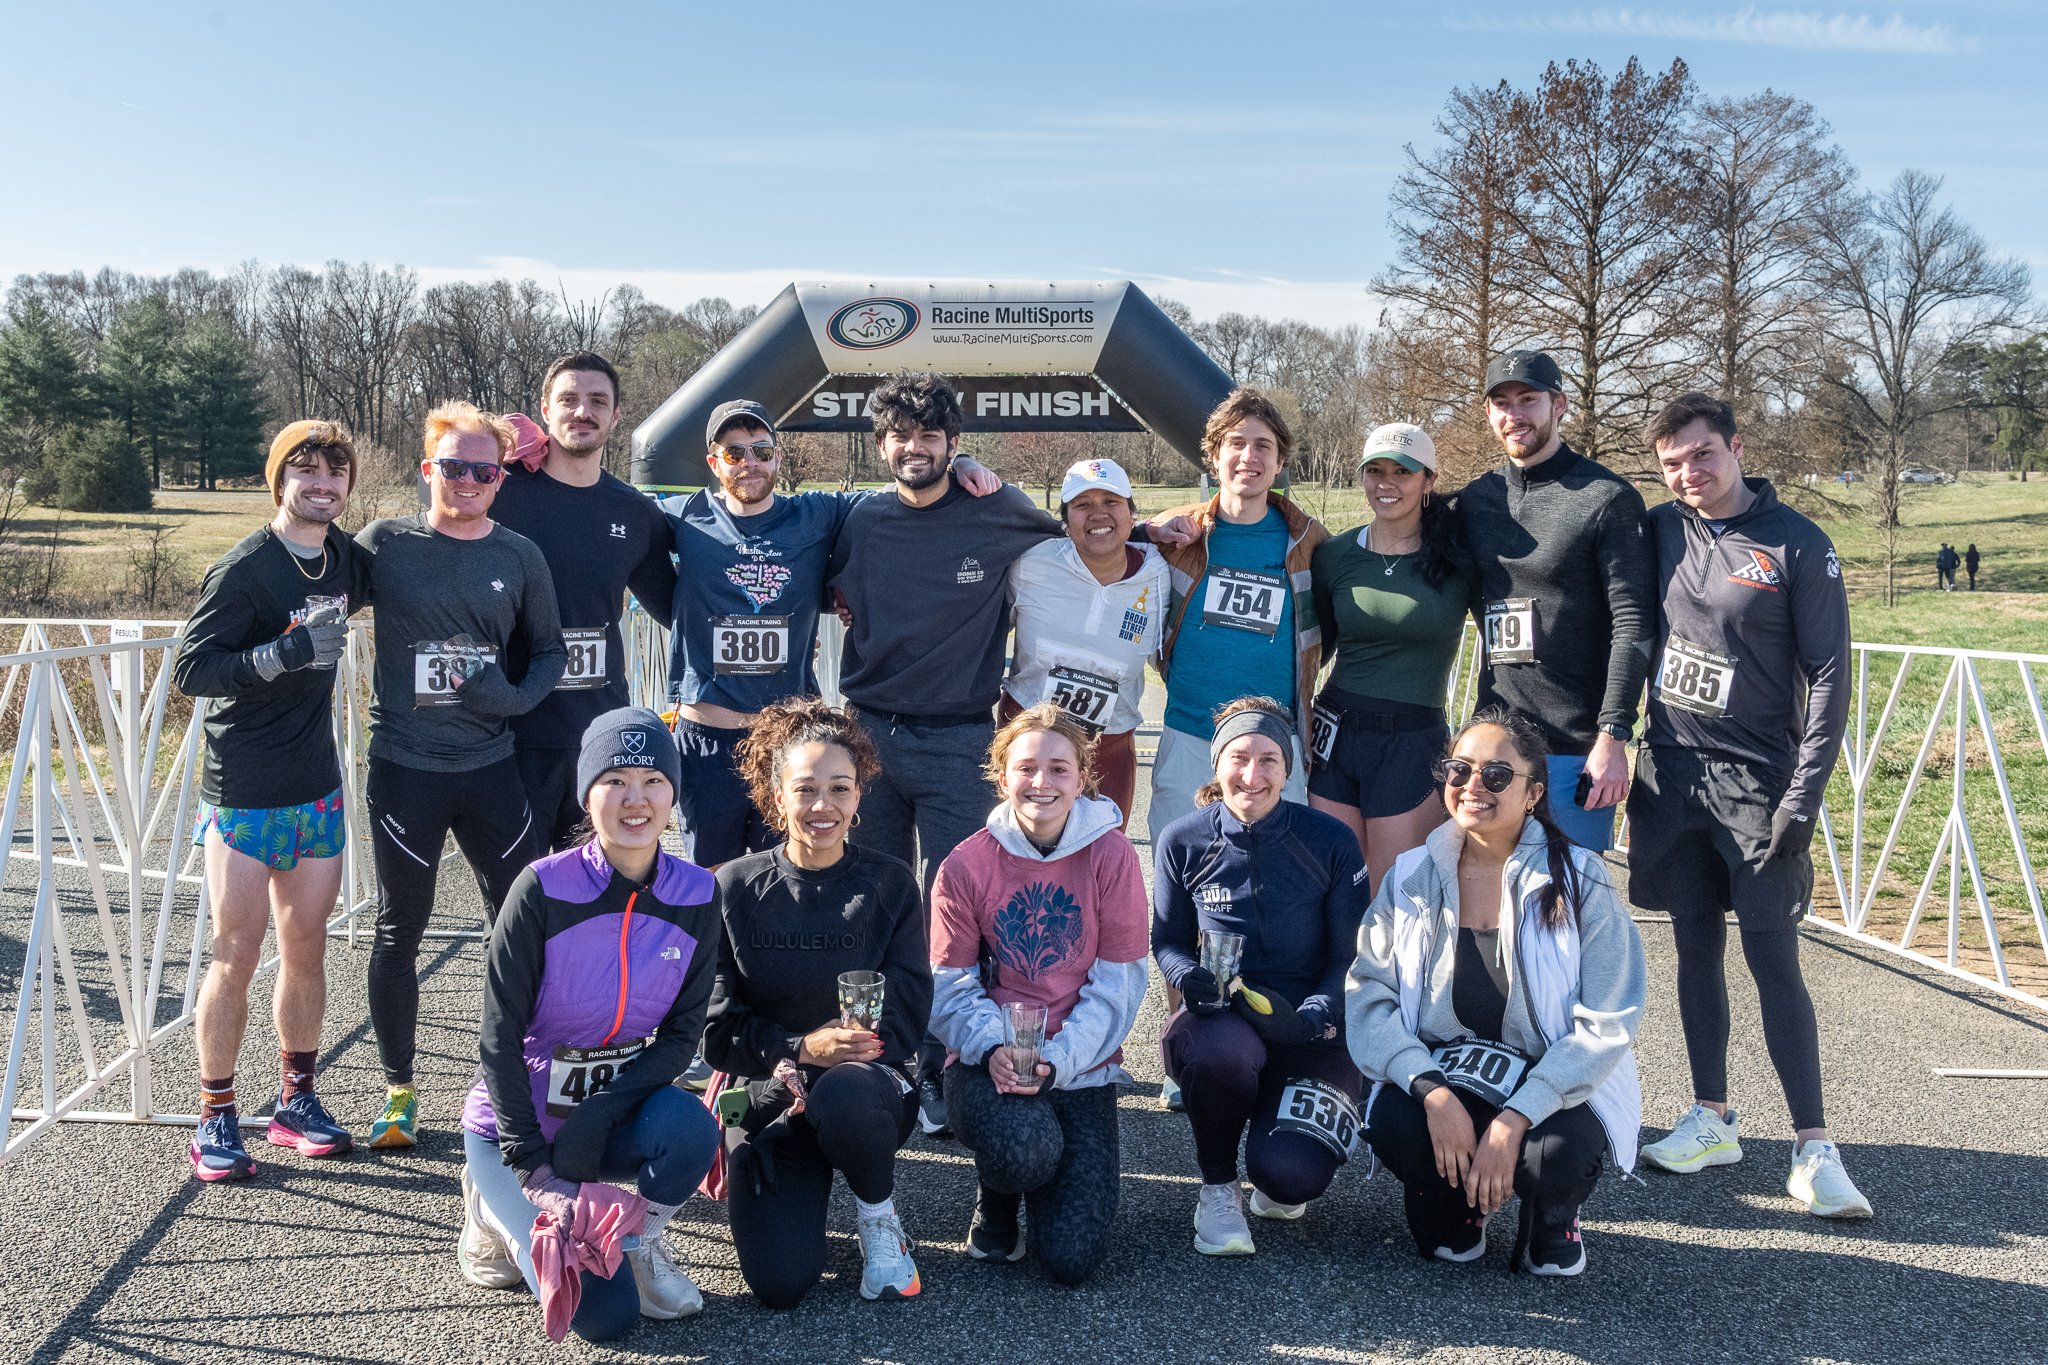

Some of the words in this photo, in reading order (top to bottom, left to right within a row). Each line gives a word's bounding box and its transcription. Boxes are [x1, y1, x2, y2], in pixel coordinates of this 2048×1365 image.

[932, 307, 990, 324] Racine
[995, 306, 1094, 328] MultiSports
[933, 333, 1093, 346] www.RacineMultiSports.com
[976, 391, 1110, 417] FINISH
[1235, 571, 1258, 581] RACINE
[1258, 575, 1280, 585] TIMING
[1217, 580, 1272, 620] 754
[1121, 620, 1146, 636] STREET
[1123, 610, 1148, 627] BROAD
[115, 629, 139, 638] RESULTS
[1118, 628, 1134, 642] RUN
[443, 645, 467, 653] RACINE
[721, 630, 780, 663] 380
[1684, 644, 1706, 658] RACINE
[1705, 651, 1729, 665] TIMING
[567, 643, 597, 677] 81
[1072, 672, 1095, 684] RACINE
[1095, 678, 1113, 690] TIMING
[1663, 653, 1723, 703] 385
[1051, 681, 1109, 722] 587
[1311, 716, 1333, 755] 88
[613, 754, 655, 766] EMORY
[386, 814, 402, 831] CRAFT
[1203, 903, 1233, 913] STAFF
[751, 931, 867, 951] LULULEMON
[588, 1049, 618, 1059] RACINE
[619, 1042, 643, 1056] TIMING
[1464, 1036, 1494, 1046] RACINE
[1494, 1041, 1521, 1056] TIMING
[1438, 1047, 1511, 1086] 540
[1317, 1082, 1343, 1100] RACINE
[1289, 1088, 1355, 1149] 536
